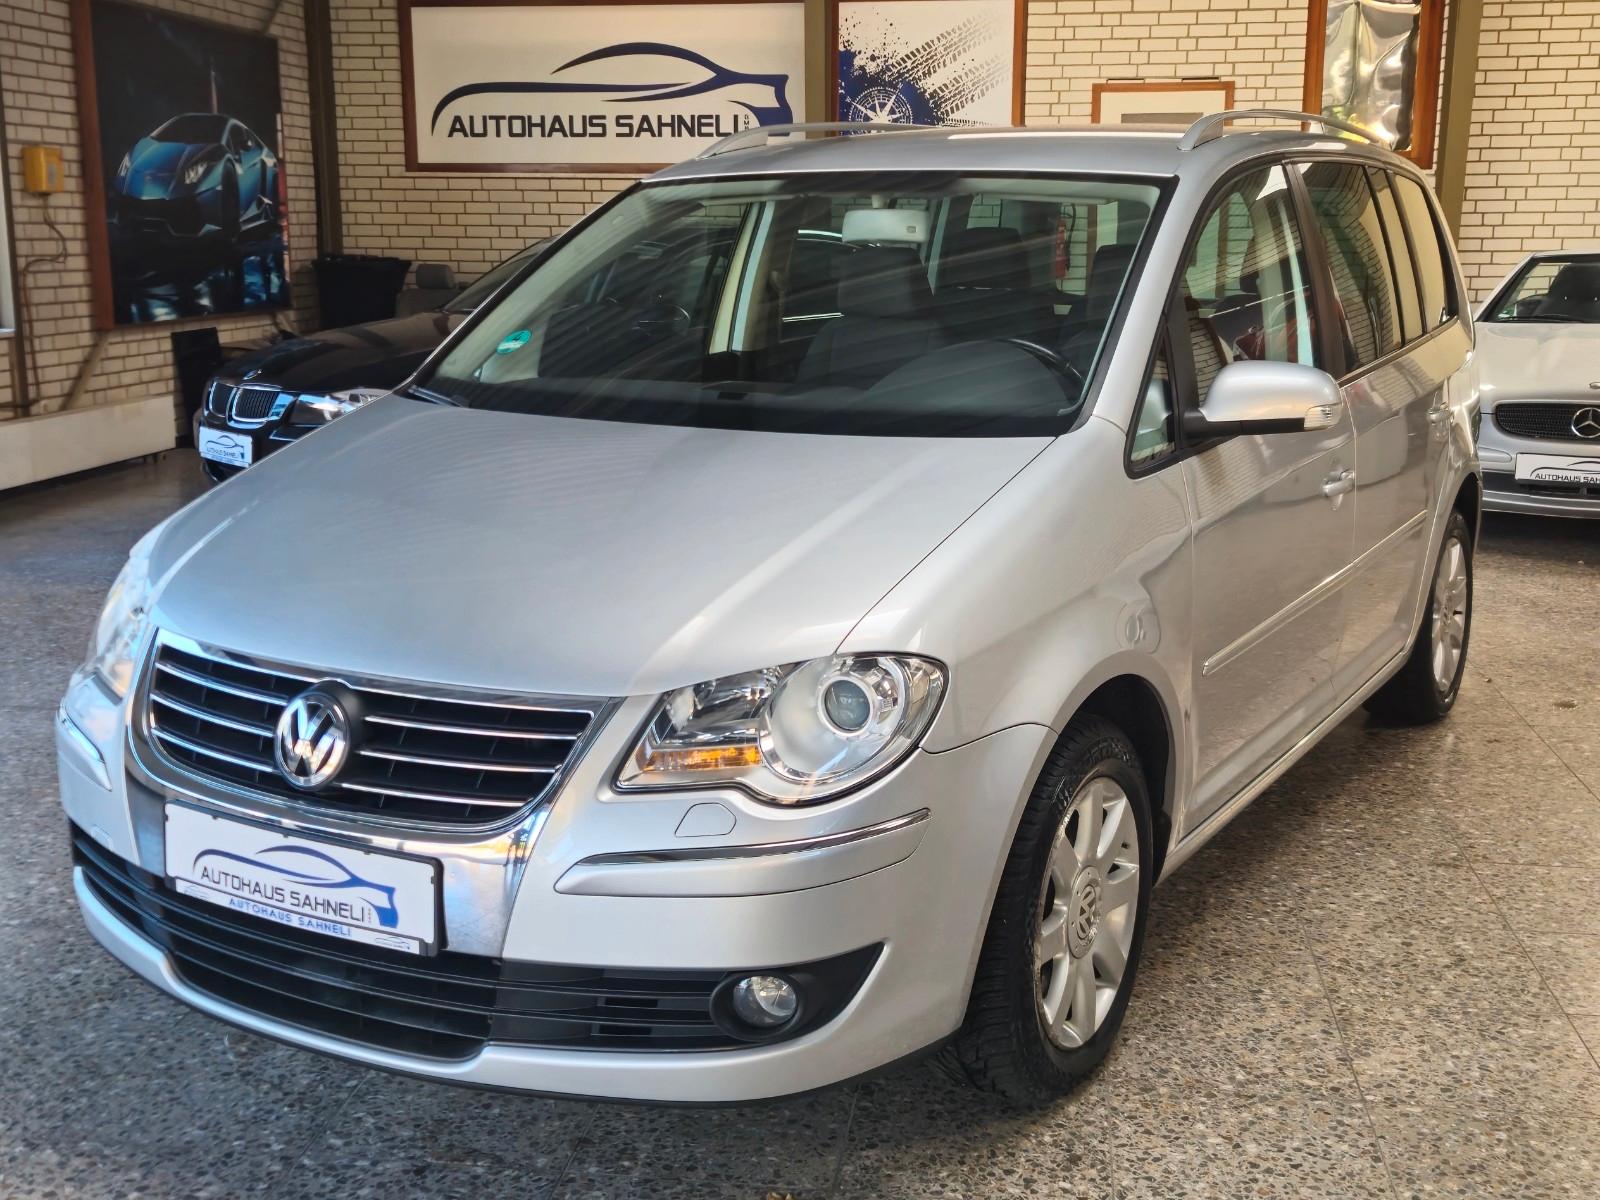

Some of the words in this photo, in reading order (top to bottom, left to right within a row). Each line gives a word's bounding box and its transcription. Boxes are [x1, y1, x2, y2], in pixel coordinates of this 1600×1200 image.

[447, 115, 607, 138] AUTOHAUS
[615, 114, 739, 138] SAHNELI
[200, 866, 285, 904] AUTOHAUS
[289, 890, 365, 923] SAHNELI
[228, 898, 293, 923] AUTOHAUS
[297, 914, 352, 938] SAHNELI
